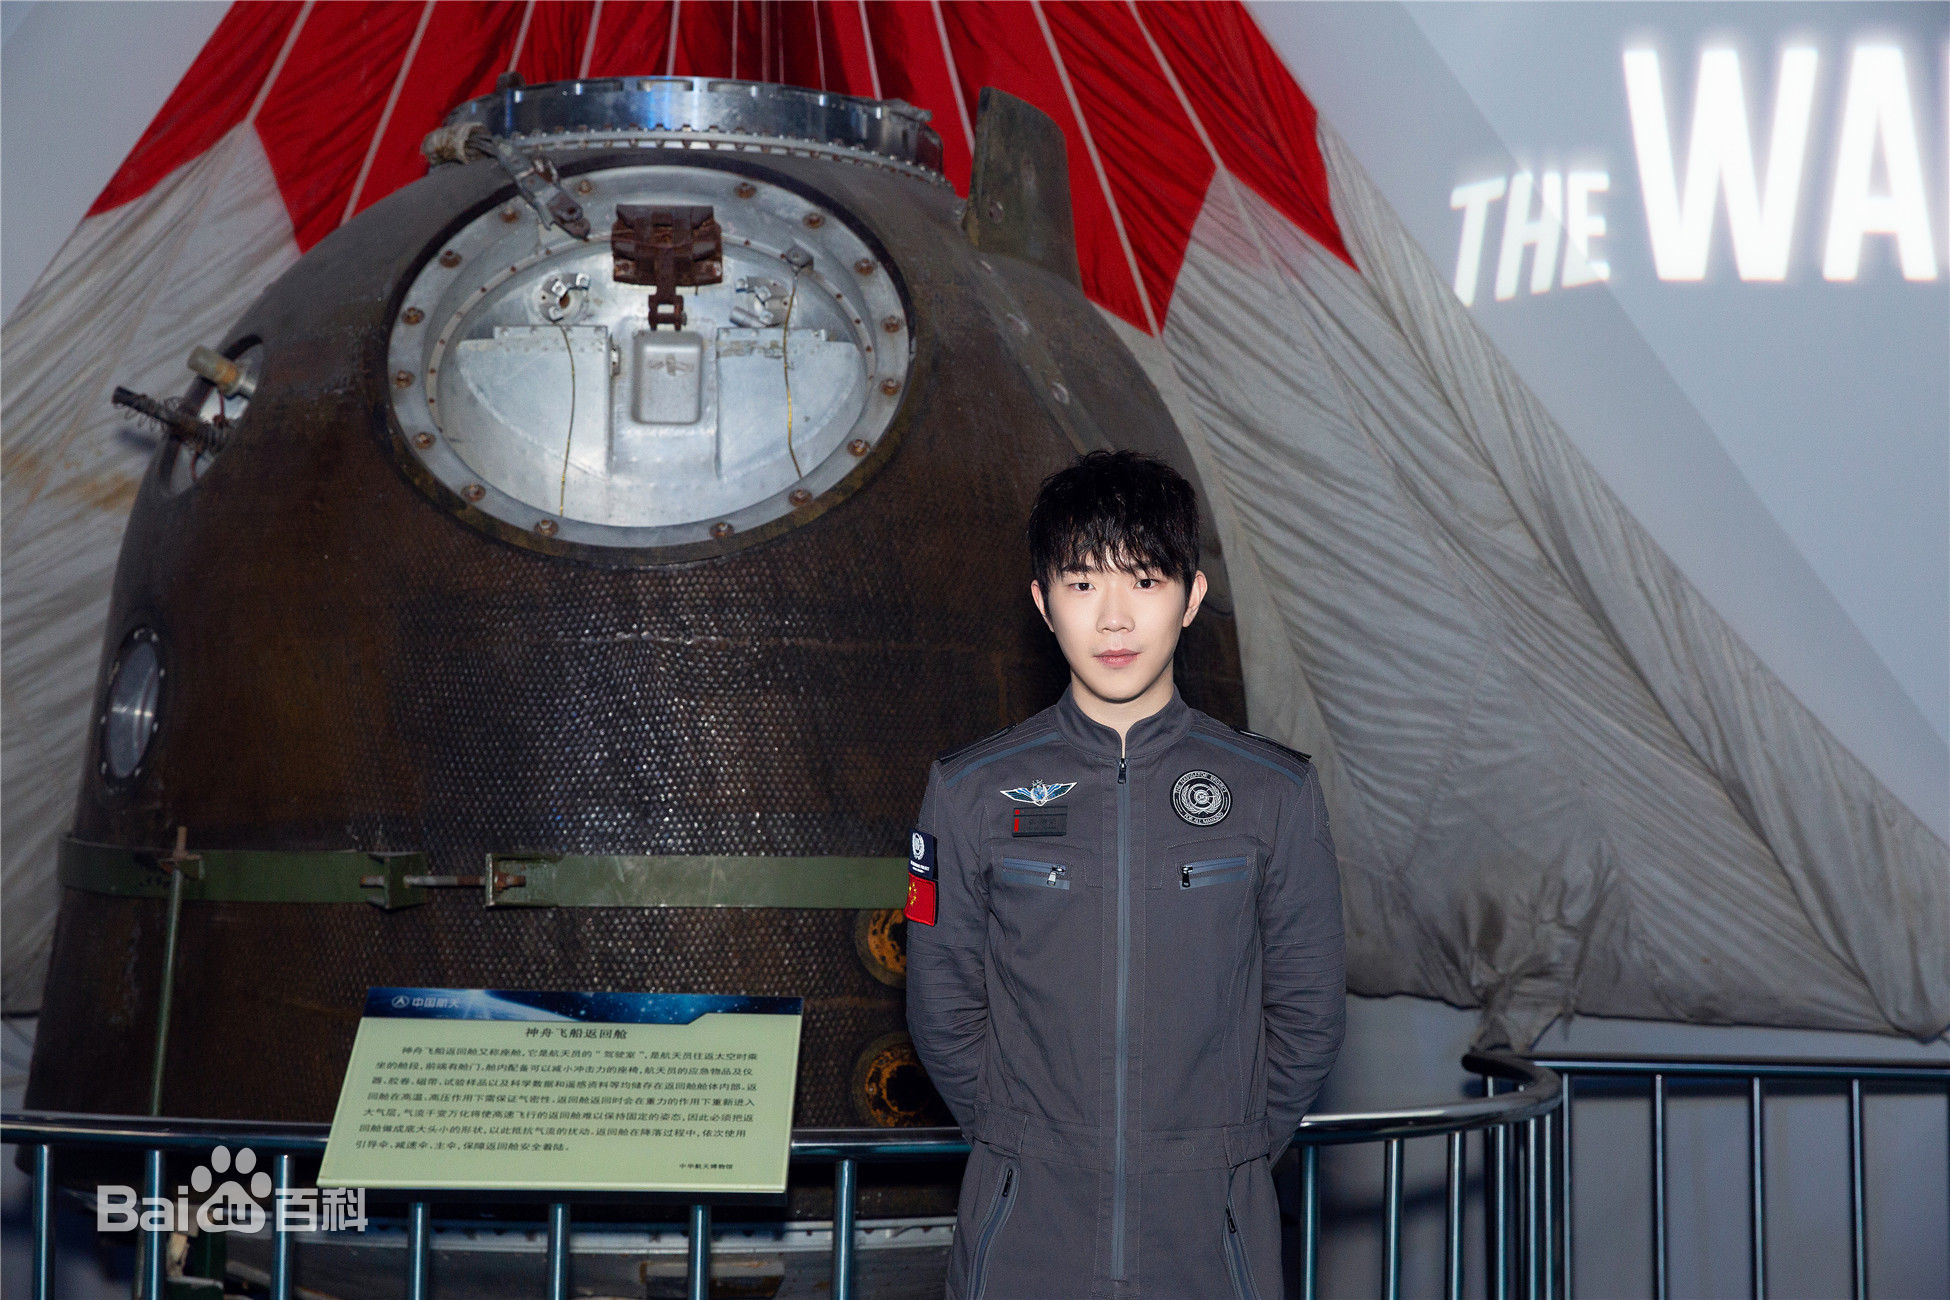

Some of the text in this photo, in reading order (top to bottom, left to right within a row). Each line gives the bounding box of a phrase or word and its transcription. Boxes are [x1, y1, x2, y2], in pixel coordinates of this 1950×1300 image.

[1450, 46, 1950, 307] THE WA
[411, 996, 460, 1009] 中国航天
[525, 1027, 628, 1040] 神舟飞船返回舱
